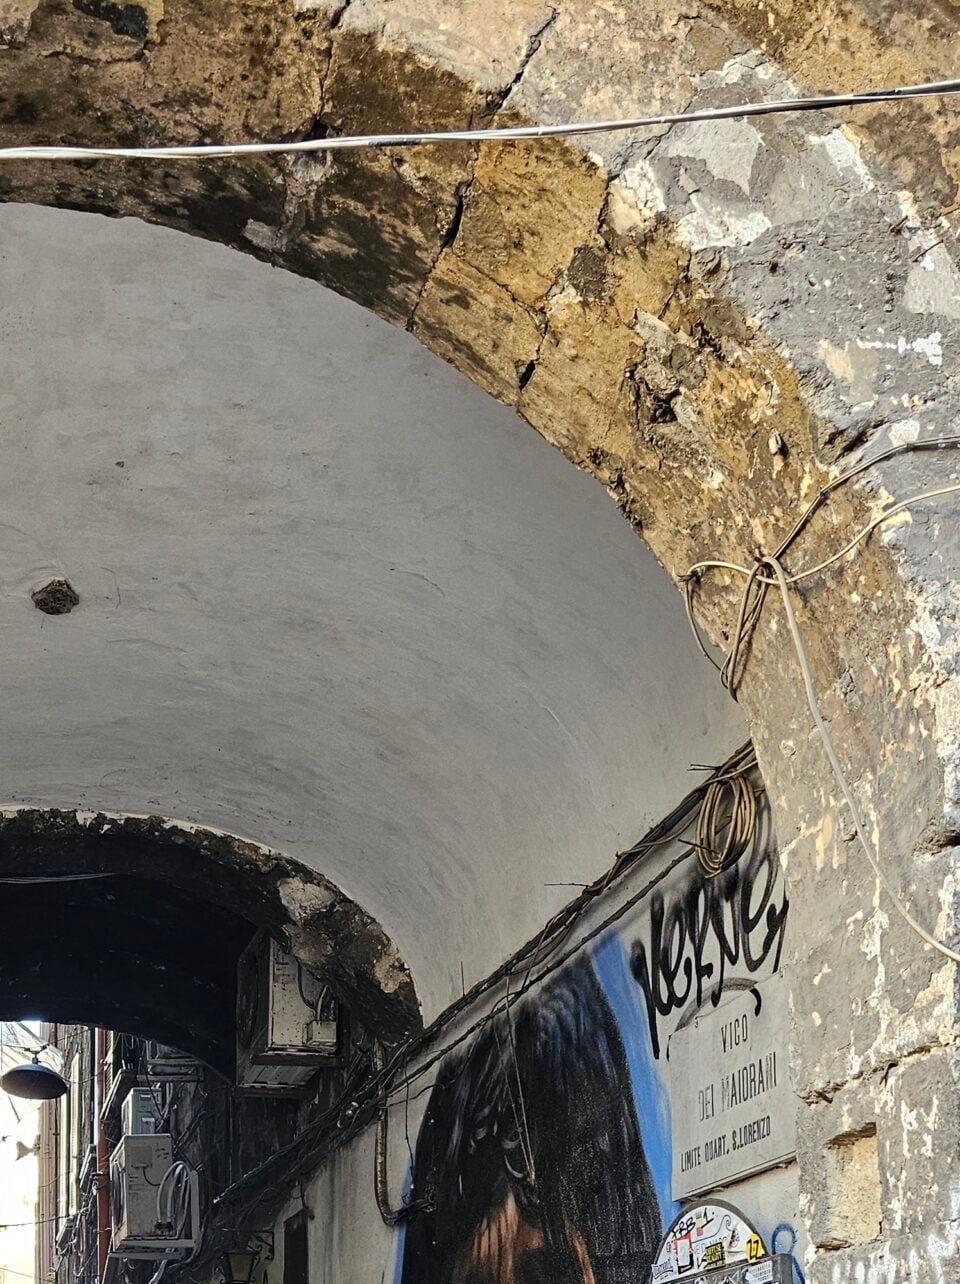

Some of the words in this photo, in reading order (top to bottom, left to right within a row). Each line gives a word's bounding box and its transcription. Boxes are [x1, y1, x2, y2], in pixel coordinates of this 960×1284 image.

[721, 1013, 749, 1054] VICO
[697, 1087, 716, 1124] DEI
[721, 1051, 778, 1115] MAIORANI
[680, 1143, 702, 1174] LIMITE
